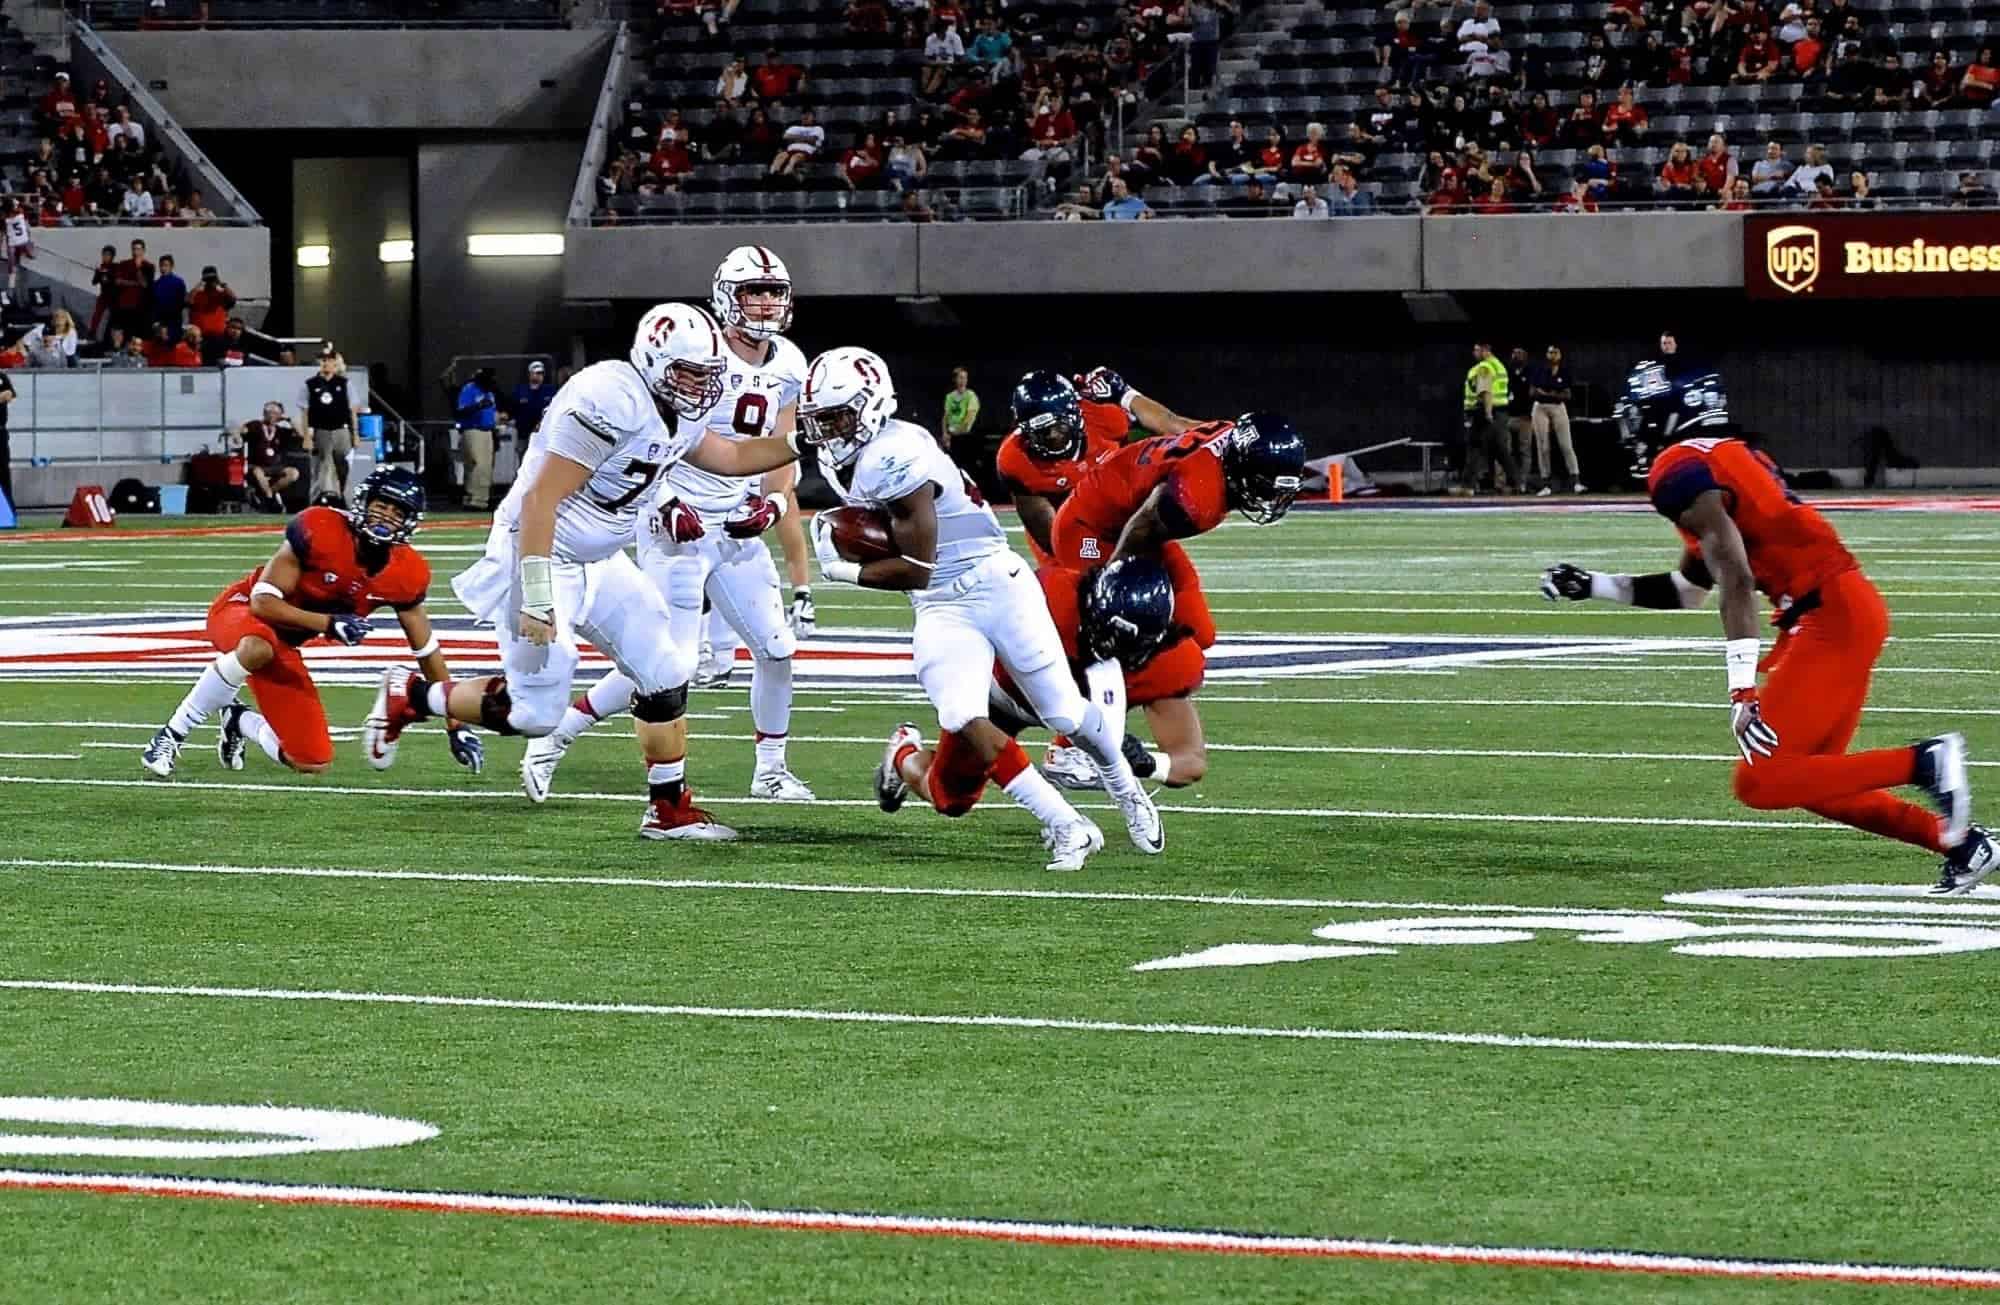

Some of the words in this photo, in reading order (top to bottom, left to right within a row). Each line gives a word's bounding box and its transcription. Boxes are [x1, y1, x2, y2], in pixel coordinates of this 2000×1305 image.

[1773, 246, 1816, 282] ups
[1844, 238, 2000, 274] Business
[85, 494, 112, 523] 10
[1080, 537, 1101, 559] A
